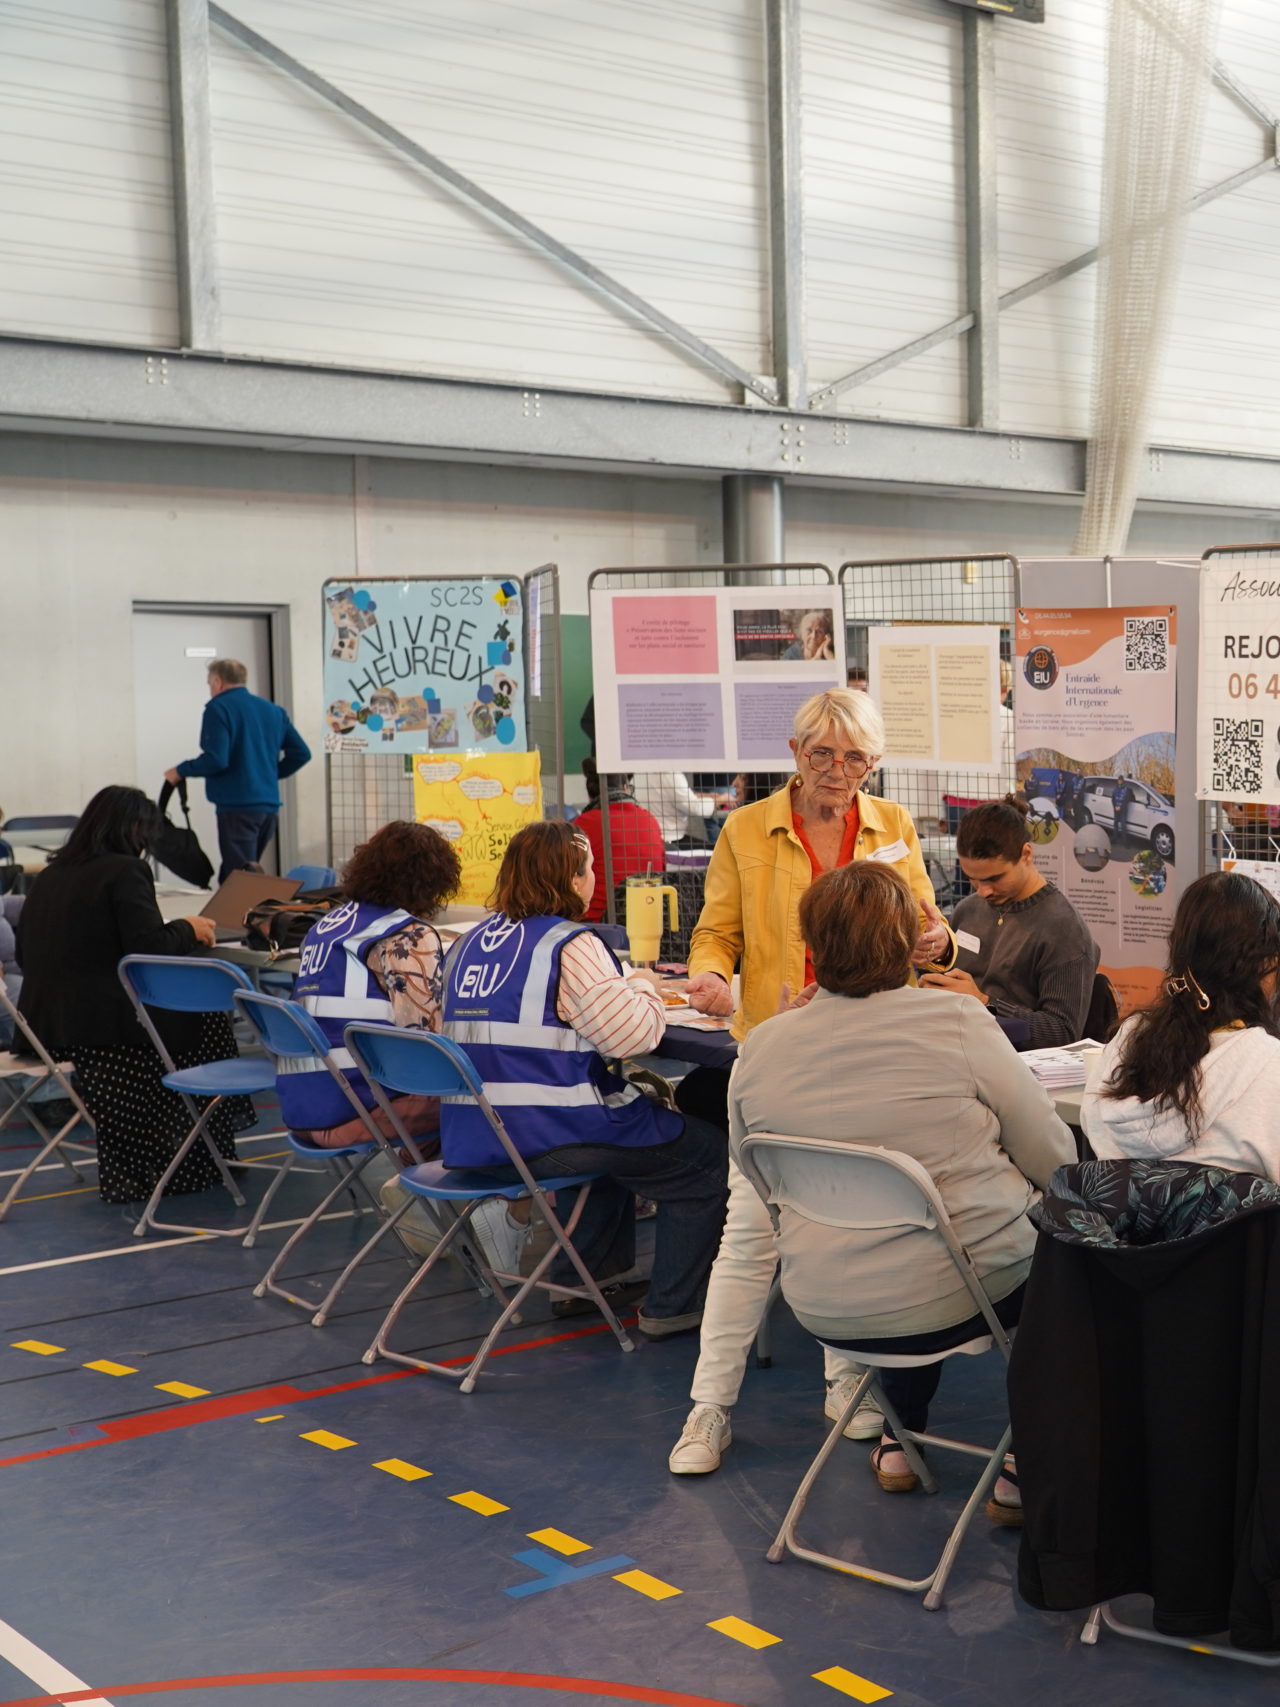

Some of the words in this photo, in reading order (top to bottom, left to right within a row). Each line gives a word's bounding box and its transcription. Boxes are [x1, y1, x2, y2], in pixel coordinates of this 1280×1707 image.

[430, 586, 484, 607] SC2S
[362, 614, 477, 654] VIVRE
[348, 645, 495, 703] HEUREUX
[1033, 671, 1050, 684] EIU
[1066, 673, 1101, 683] Entraide
[1228, 673, 1258, 699] 06
[299, 942, 324, 977] EIU
[458, 963, 500, 998] EIU
